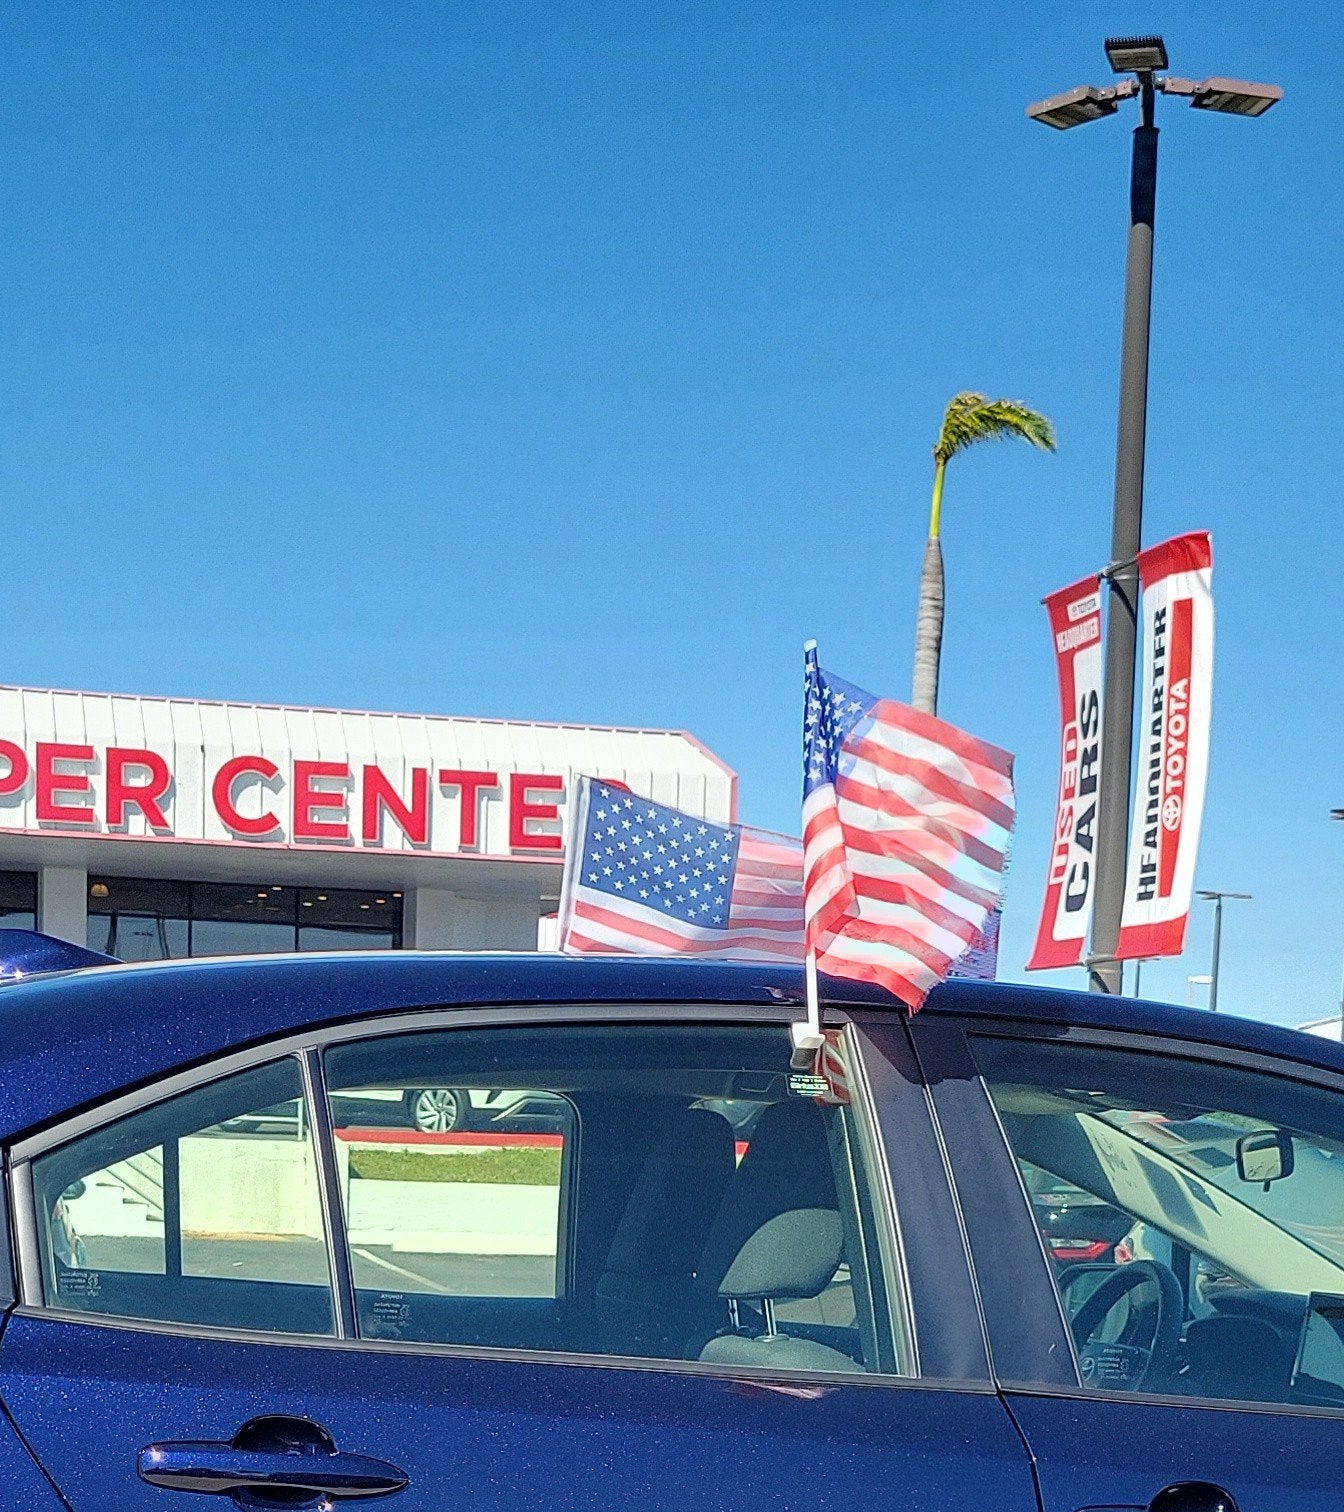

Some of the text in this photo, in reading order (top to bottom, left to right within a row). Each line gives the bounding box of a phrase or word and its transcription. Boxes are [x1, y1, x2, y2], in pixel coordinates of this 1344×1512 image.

[212, 756, 632, 850] CENTE
[1050, 725, 1078, 882] USED
[1065, 690, 1099, 912] CARS
[1165, 677, 1189, 795] TOYOTA
